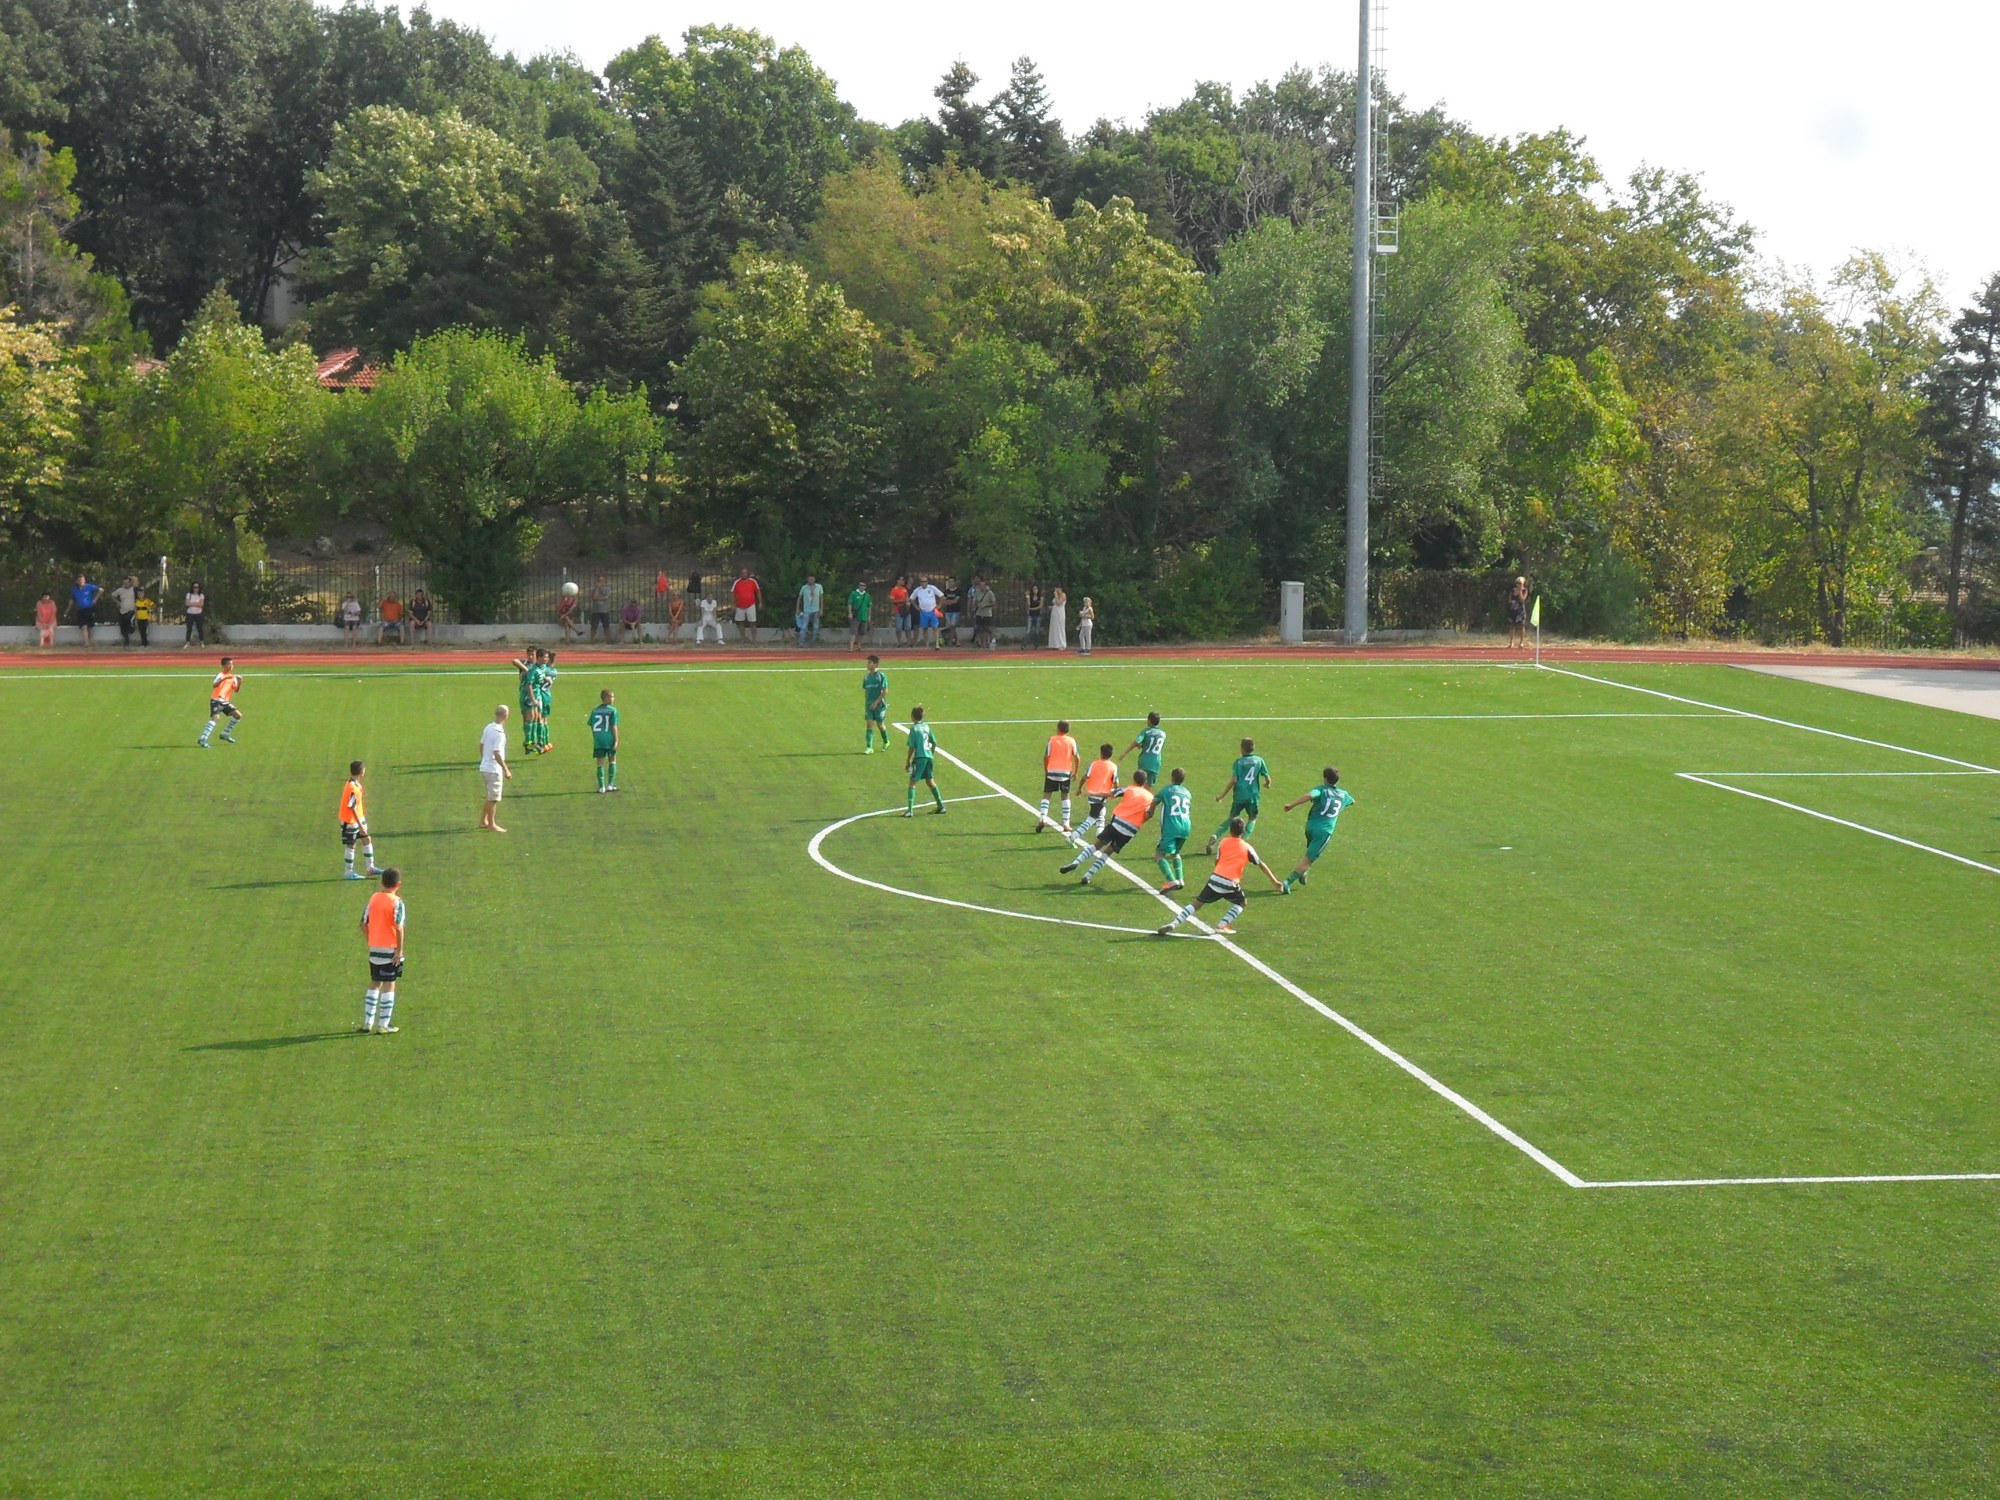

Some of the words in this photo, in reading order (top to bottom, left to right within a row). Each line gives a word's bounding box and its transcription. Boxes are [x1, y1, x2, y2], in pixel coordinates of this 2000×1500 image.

[593, 714, 610, 732] 21
[1145, 736, 1164, 755] 18
[1244, 766, 1255, 785] 4
[1170, 795, 1190, 818] 25
[1320, 798, 1342, 818] 13
